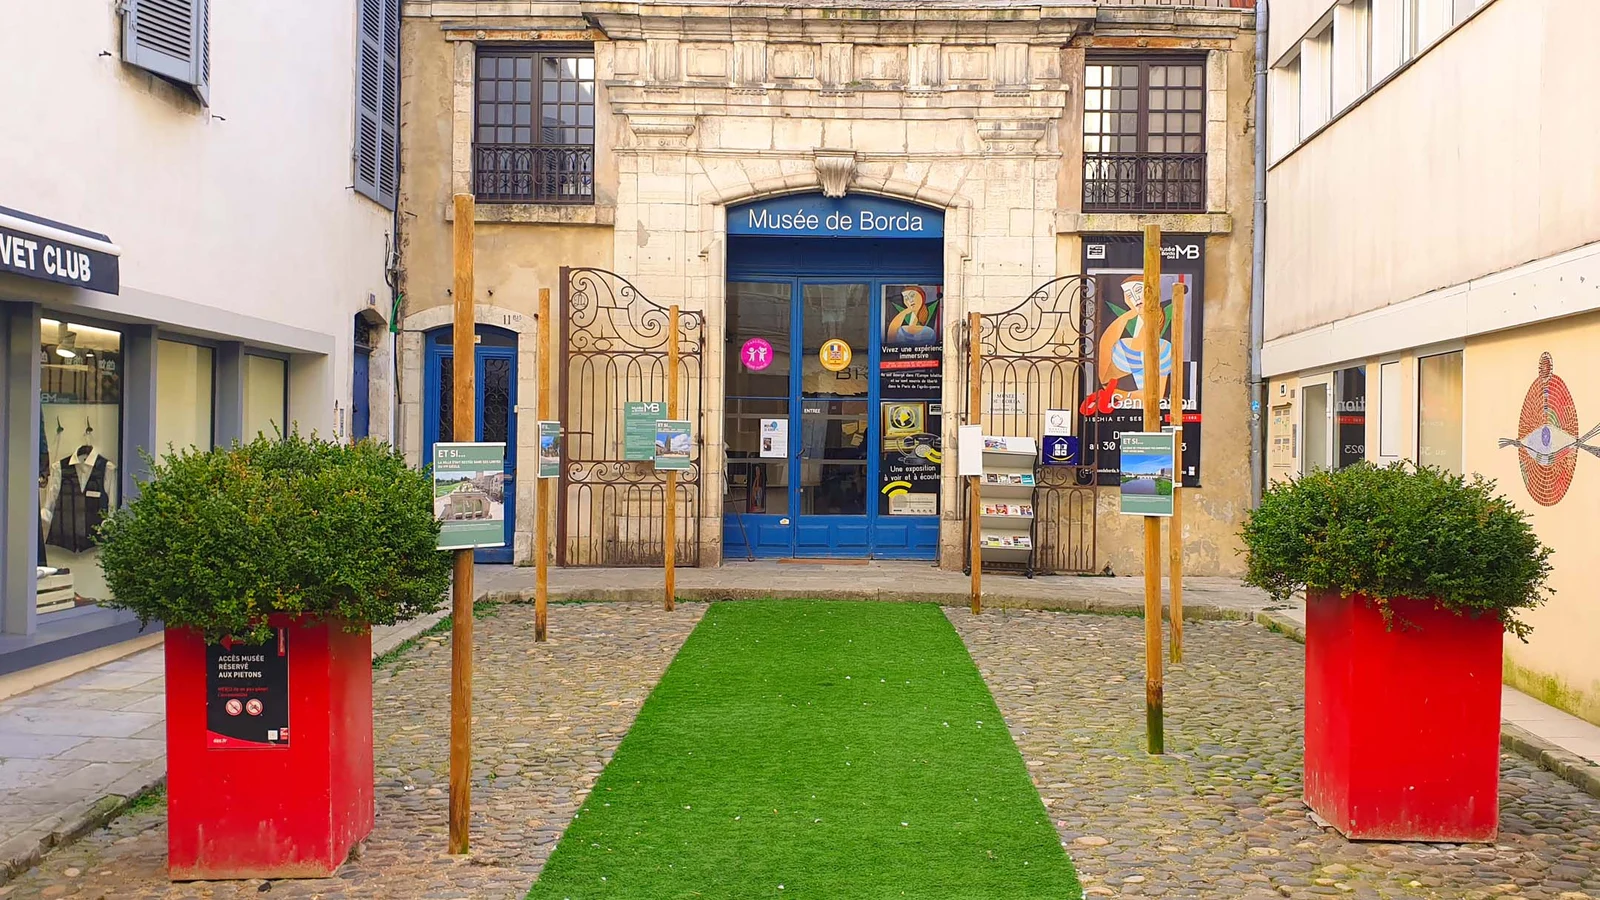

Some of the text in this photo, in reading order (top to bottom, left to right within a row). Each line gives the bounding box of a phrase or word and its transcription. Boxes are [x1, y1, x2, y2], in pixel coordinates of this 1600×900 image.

[748, 208, 924, 232] Musée de Borda
[1175, 244, 1200, 259] MB
[43, 244, 91, 282] CLUB
[1102, 441, 1116, 451] 30
[1122, 437, 1131, 445] ET
[438, 449, 449, 458] ET
[889, 464, 937, 474] Une exposition
[883, 473, 889, 481] à
[890, 473, 902, 481] voir
[913, 472, 918, 480] à
